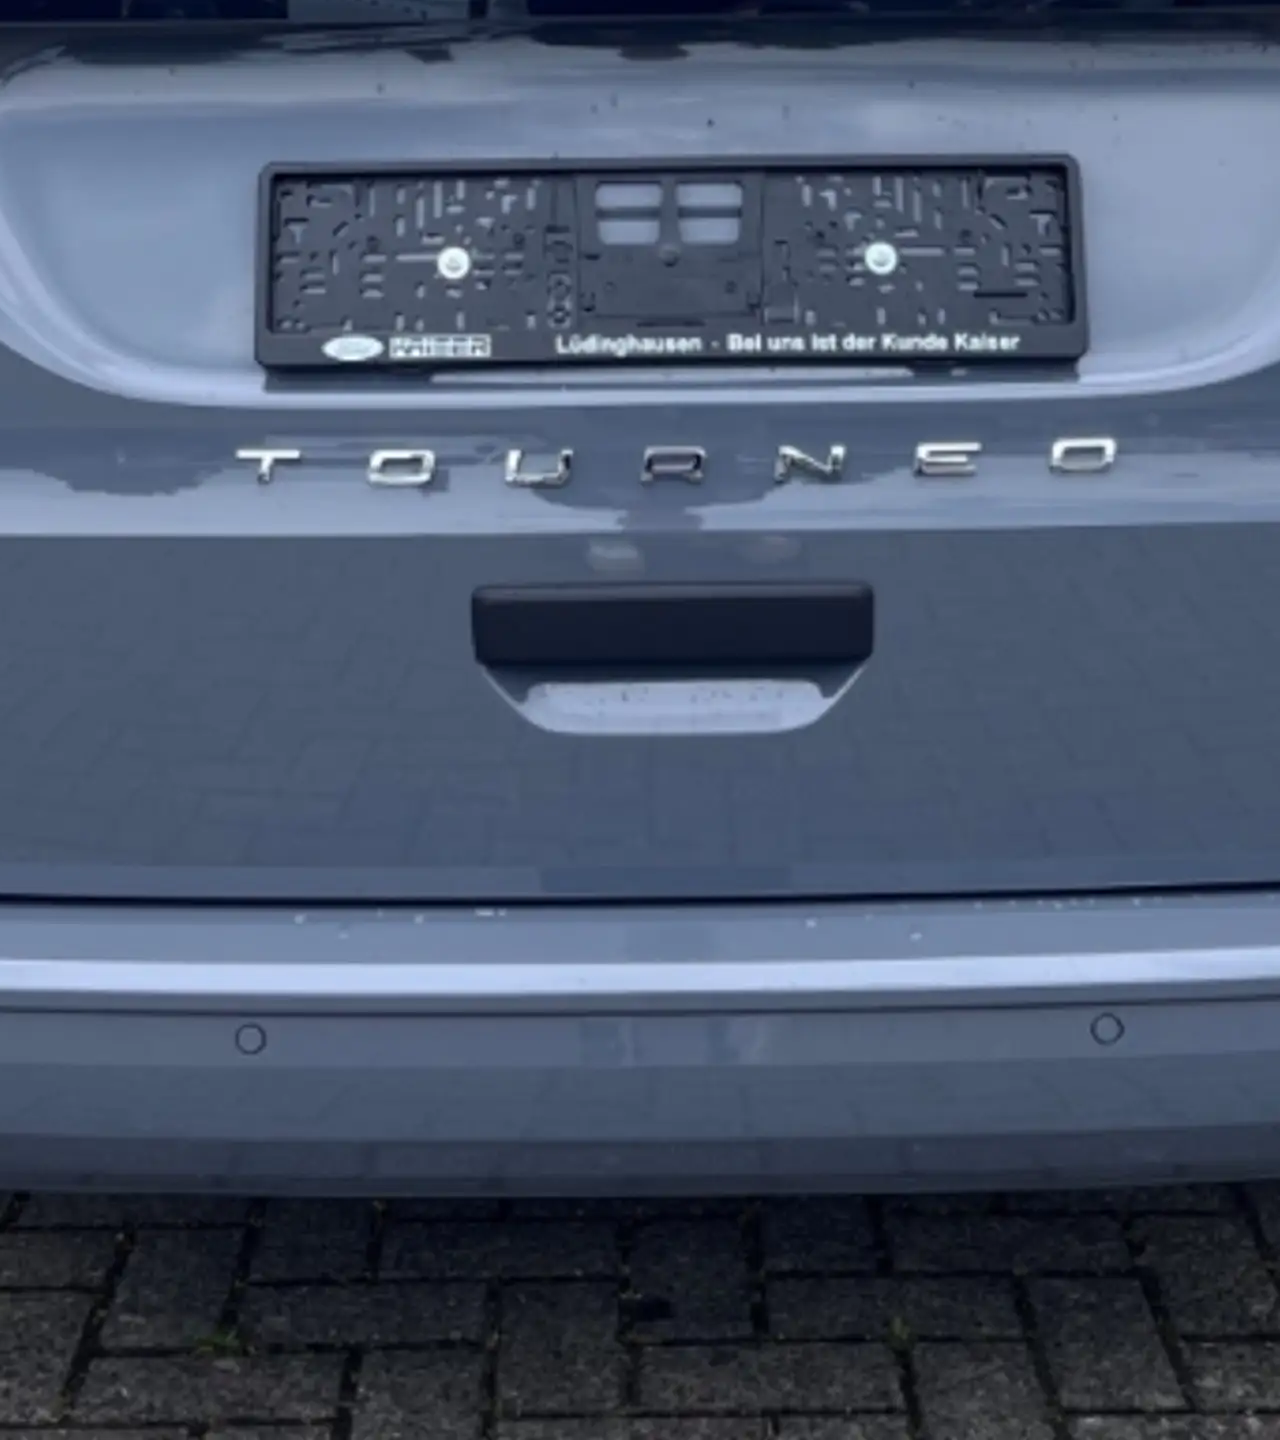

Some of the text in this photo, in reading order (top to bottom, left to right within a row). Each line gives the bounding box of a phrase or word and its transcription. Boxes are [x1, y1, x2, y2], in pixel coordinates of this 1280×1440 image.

[554, 332, 703, 358] Lüdinghausen
[766, 336, 806, 352] uns
[841, 333, 877, 352] der
[880, 333, 949, 352] Kunde
[953, 333, 1021, 352] Kaiser
[235, 436, 1117, 486] TOURNEO
